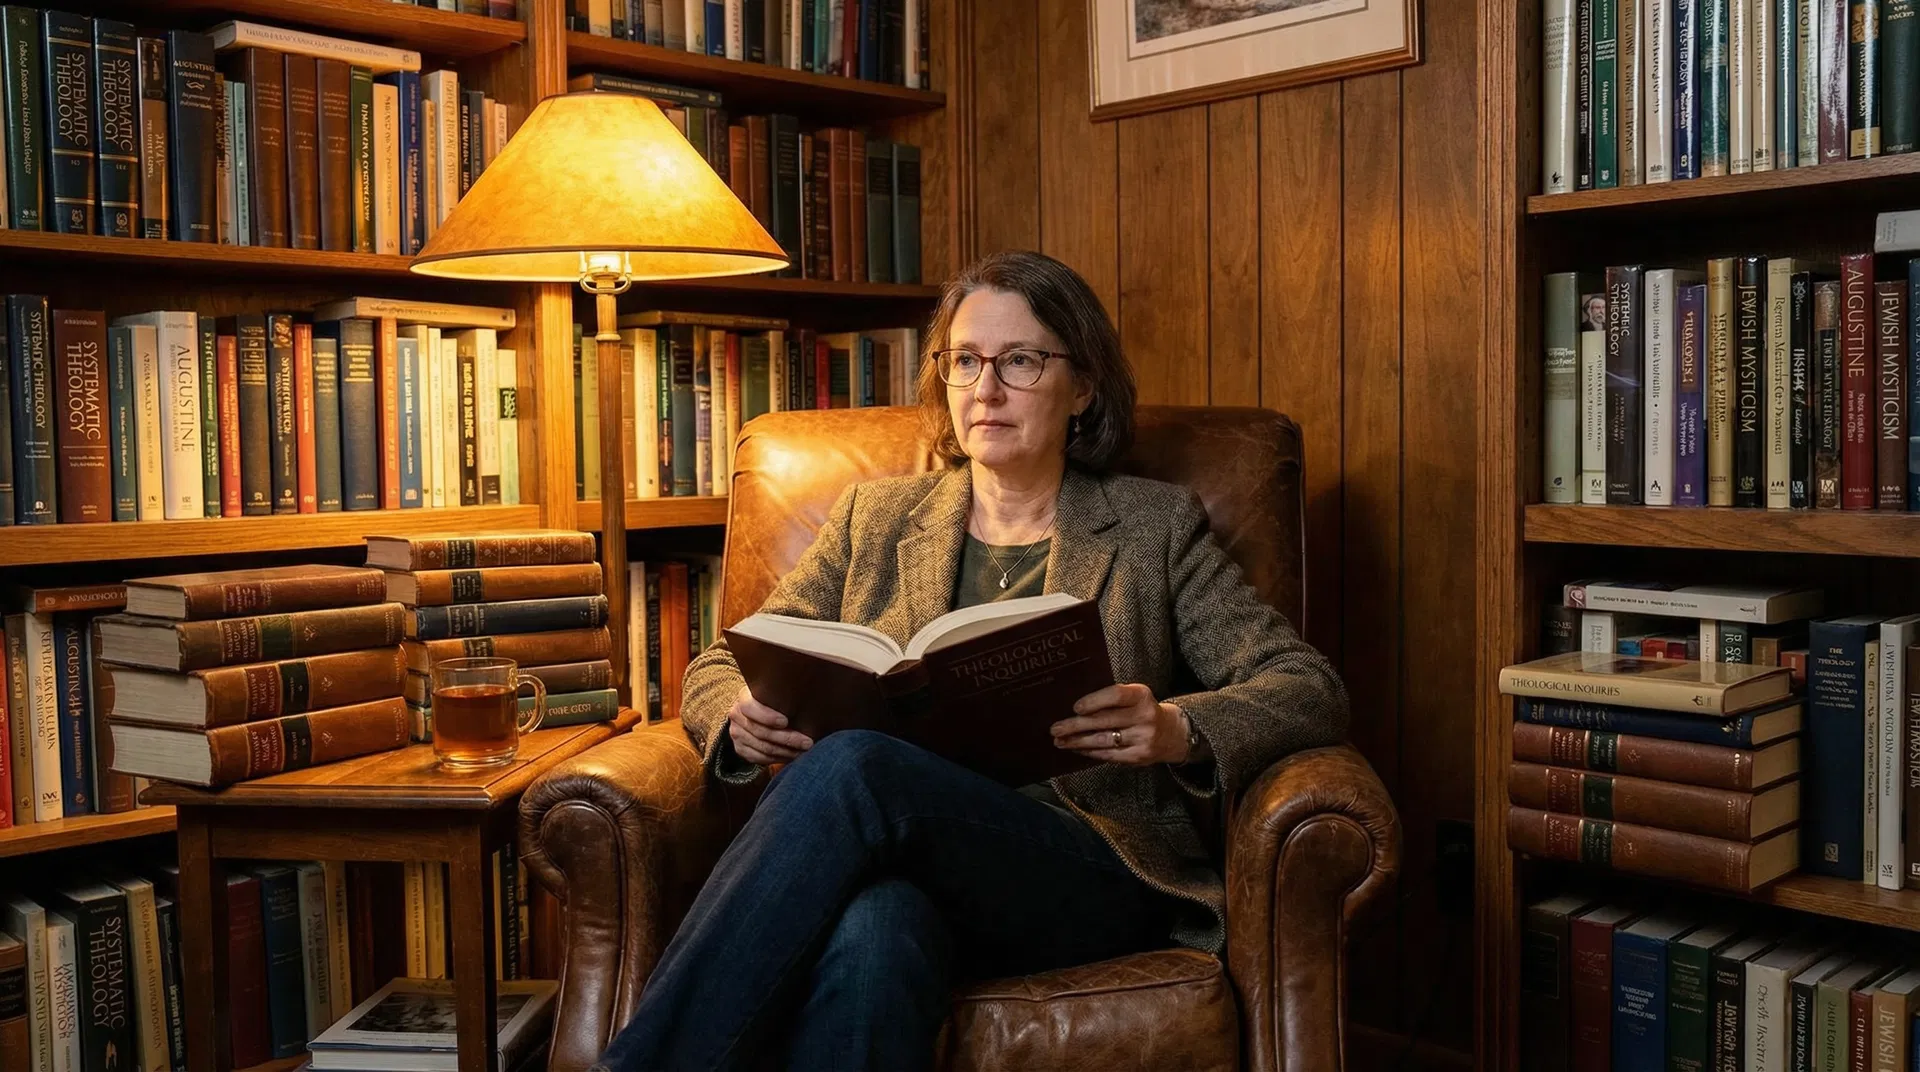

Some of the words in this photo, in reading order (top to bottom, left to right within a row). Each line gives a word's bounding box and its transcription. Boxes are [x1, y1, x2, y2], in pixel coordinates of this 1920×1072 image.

[55, 53, 74, 141] THEOLOGY
[71, 52, 89, 147] SYSTEMATIC
[101, 59, 119, 145] THEOLOGY
[116, 58, 134, 152] SYSTEMATIC
[1738, 284, 1756, 341] JEWISH
[1847, 268, 1865, 378] AUGUSTINE
[1879, 291, 1900, 347] JEWISH
[66, 343, 85, 435] THEOLOGY
[83, 341, 101, 441] SYSTEMATIC
[177, 344, 195, 453] AUGUSTINE
[1741, 346, 1756, 433] MYSTICISM
[1882, 353, 1900, 440] MYSTICISM
[951, 629, 1084, 680] THEOLOGICAL
[973, 648, 1068, 688] INQUIRIES
[1510, 677, 1573, 692] THEOLOGICAL
[89, 926, 109, 1029] THEOLOGY
[105, 916, 125, 1030] SYSTEMATIC
[1879, 1005, 1895, 1065] JEWISH
